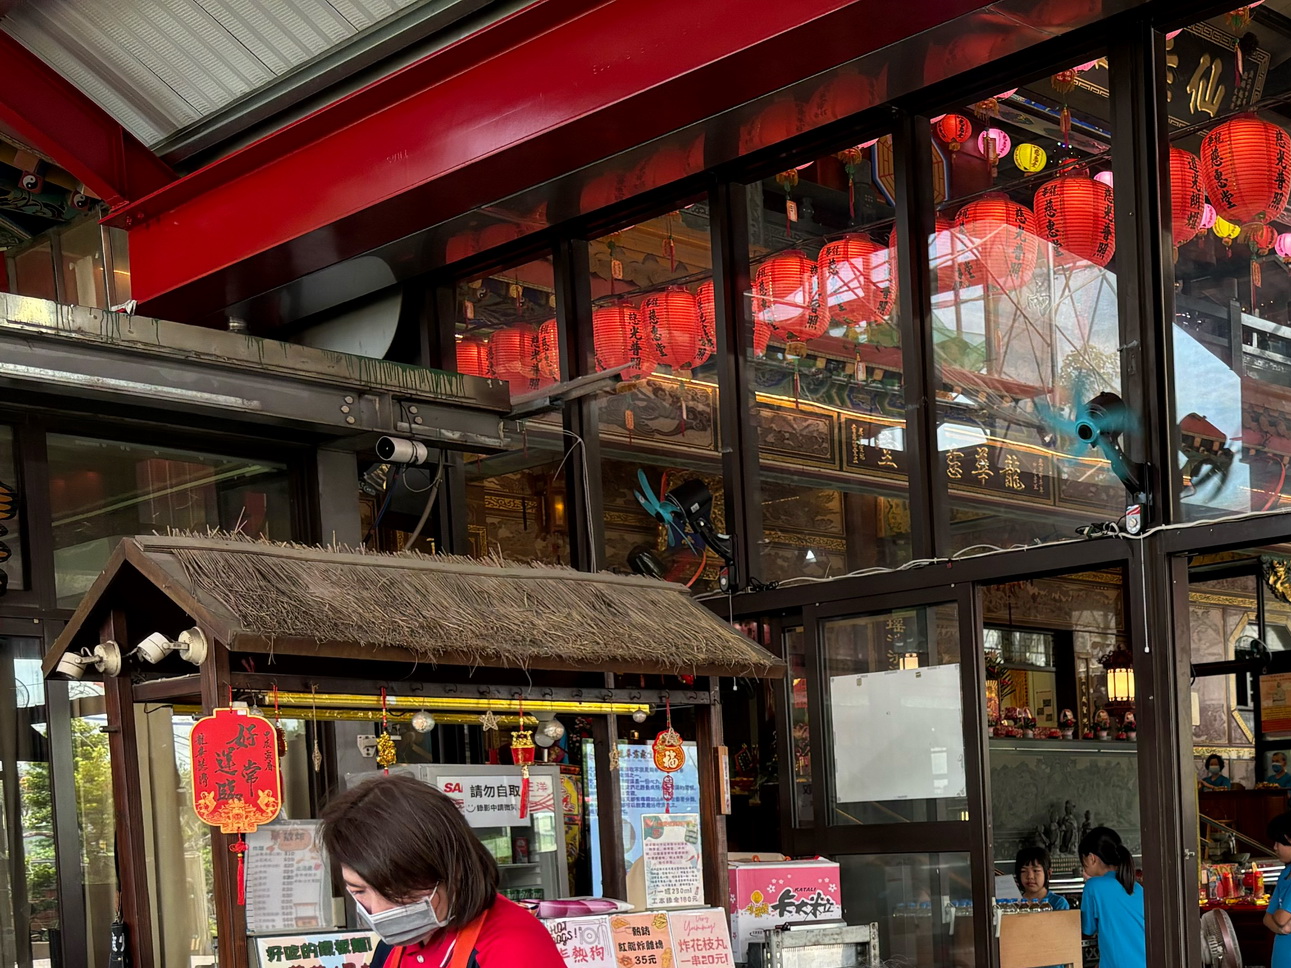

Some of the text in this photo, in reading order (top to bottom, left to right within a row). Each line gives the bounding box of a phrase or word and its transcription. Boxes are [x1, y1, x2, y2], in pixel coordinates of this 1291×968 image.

[1267, 129, 1289, 211] 慈光普照
[213, 724, 262, 802] 好運常臨
[663, 750, 678, 768] 福
[470, 785, 520, 798] 請勿自取
[678, 938, 728, 953] 炸花枝丸
[634, 955, 657, 965] 35元
